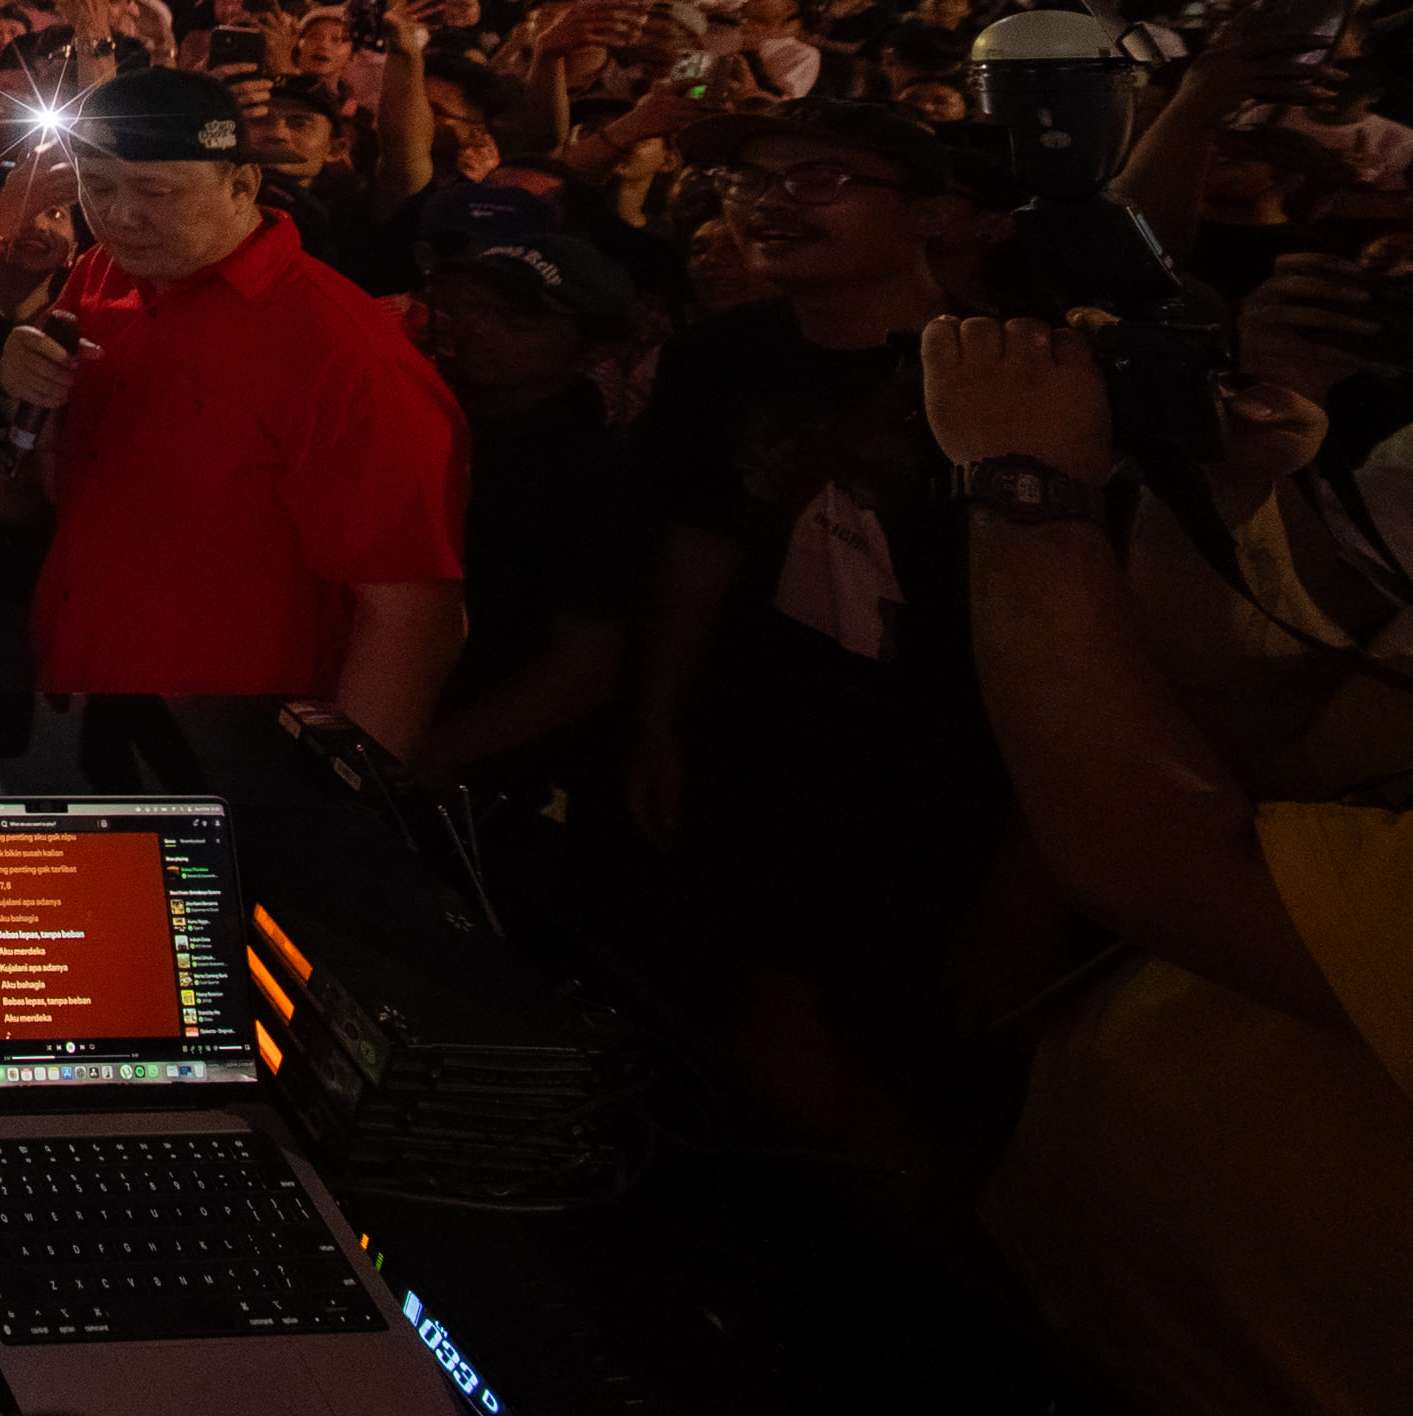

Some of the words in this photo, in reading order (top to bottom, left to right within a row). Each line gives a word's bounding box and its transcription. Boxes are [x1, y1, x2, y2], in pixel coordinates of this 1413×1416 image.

[11, 914, 40, 924] bahagia
[40, 930, 61, 940] tanpa
[61, 929, 85, 939] beban
[13, 946, 46, 956] merdeka
[28, 964, 42, 973] apa
[42, 963, 69, 973] adanya
[1, 980, 16, 989] Aku
[16, 980, 46, 991] bahagia
[2, 996, 24, 1006] Bebas
[46, 996, 67, 1007] tanpa
[67, 995, 92, 1005] beban
[4, 1013, 19, 1023] Aku
[19, 1013, 53, 1023] merdeka
